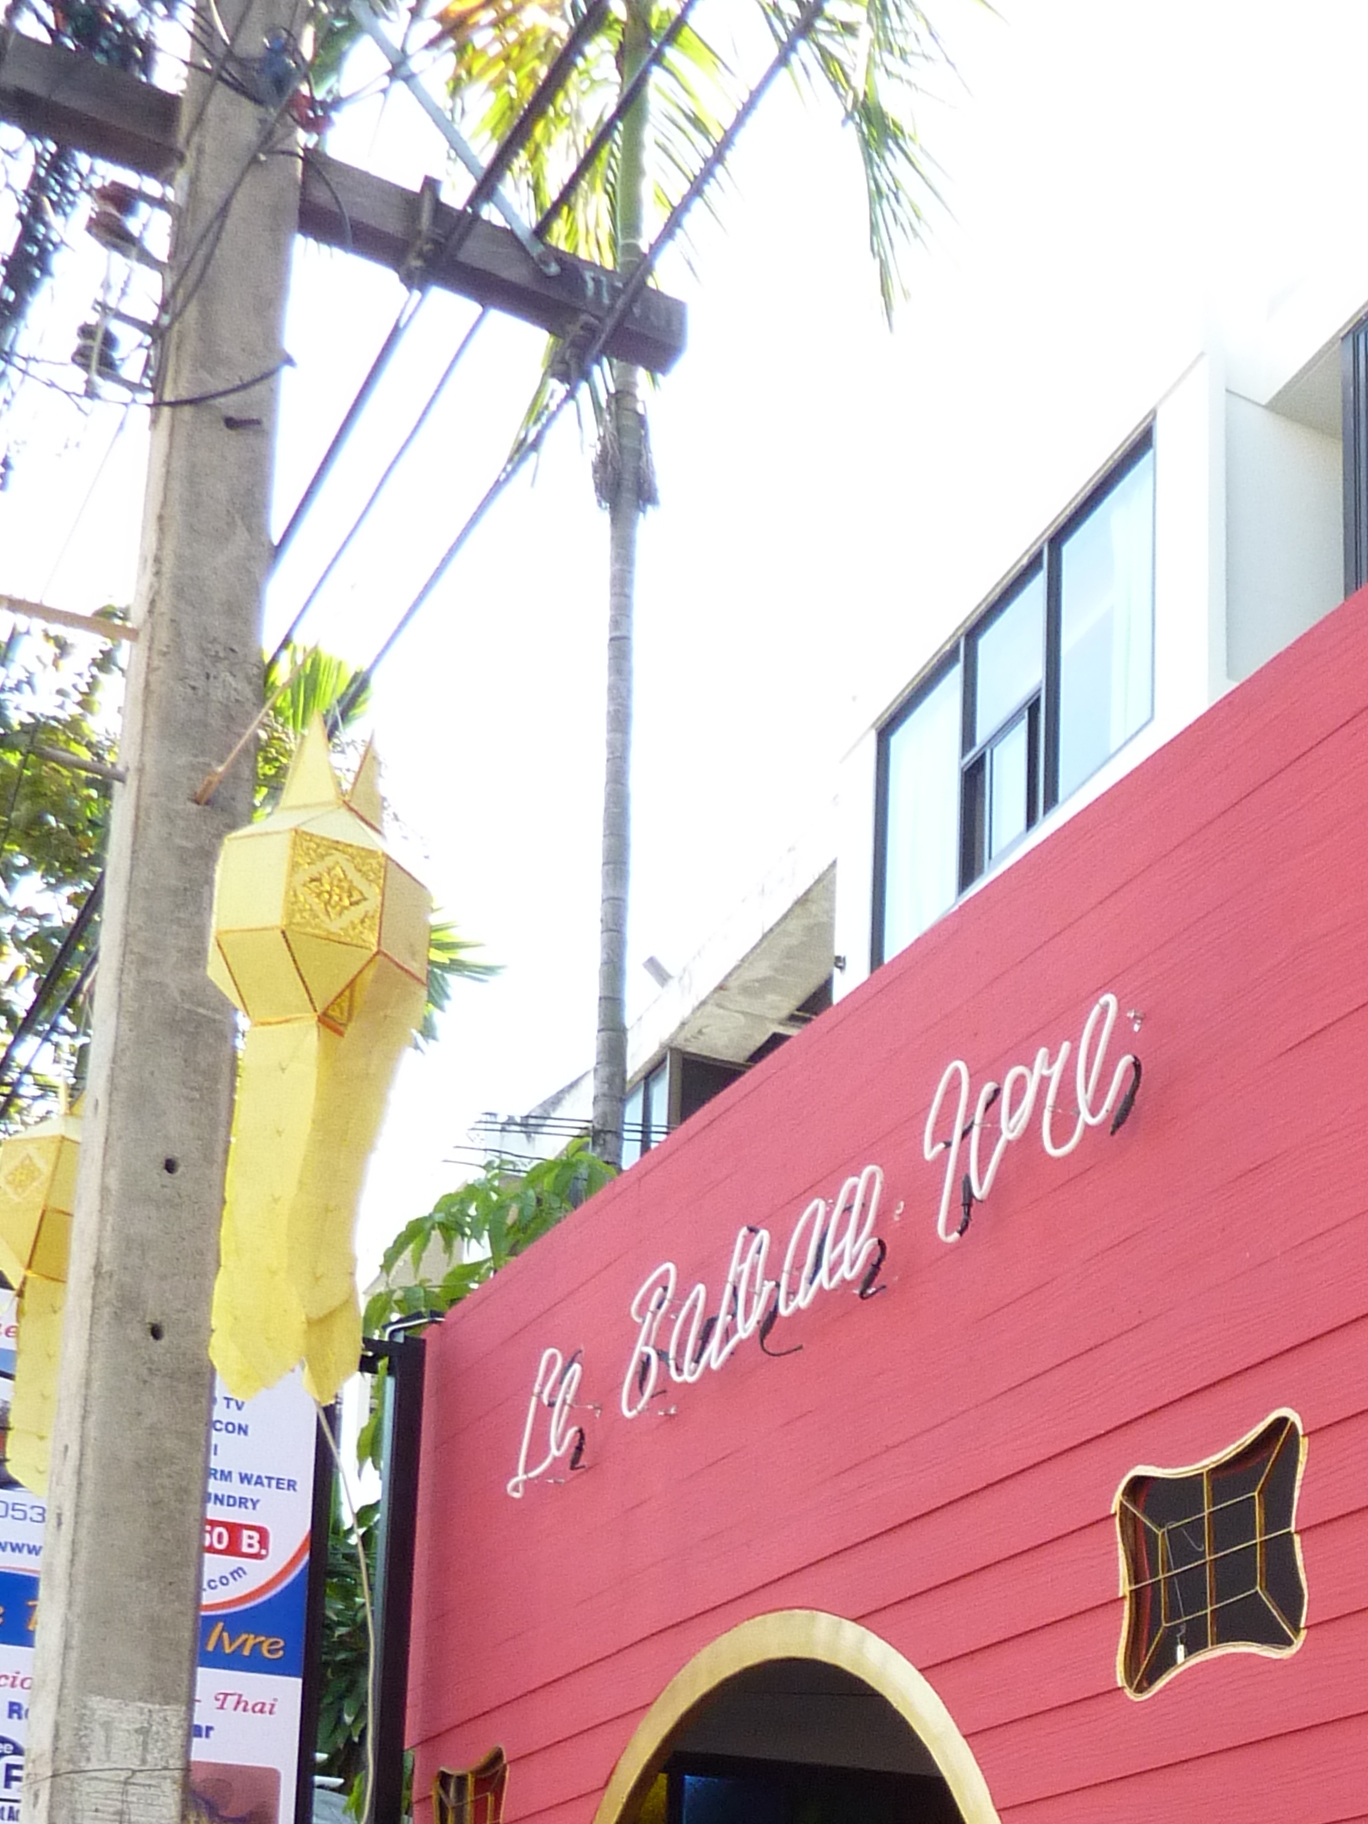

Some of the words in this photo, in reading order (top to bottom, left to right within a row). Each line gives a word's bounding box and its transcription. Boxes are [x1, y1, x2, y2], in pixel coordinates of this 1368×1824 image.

[223, 1396, 246, 1412] TV
[238, 1471, 298, 1493] WATER
[205, 1621, 285, 1660] Ivre
[214, 1691, 278, 1716] Thai
